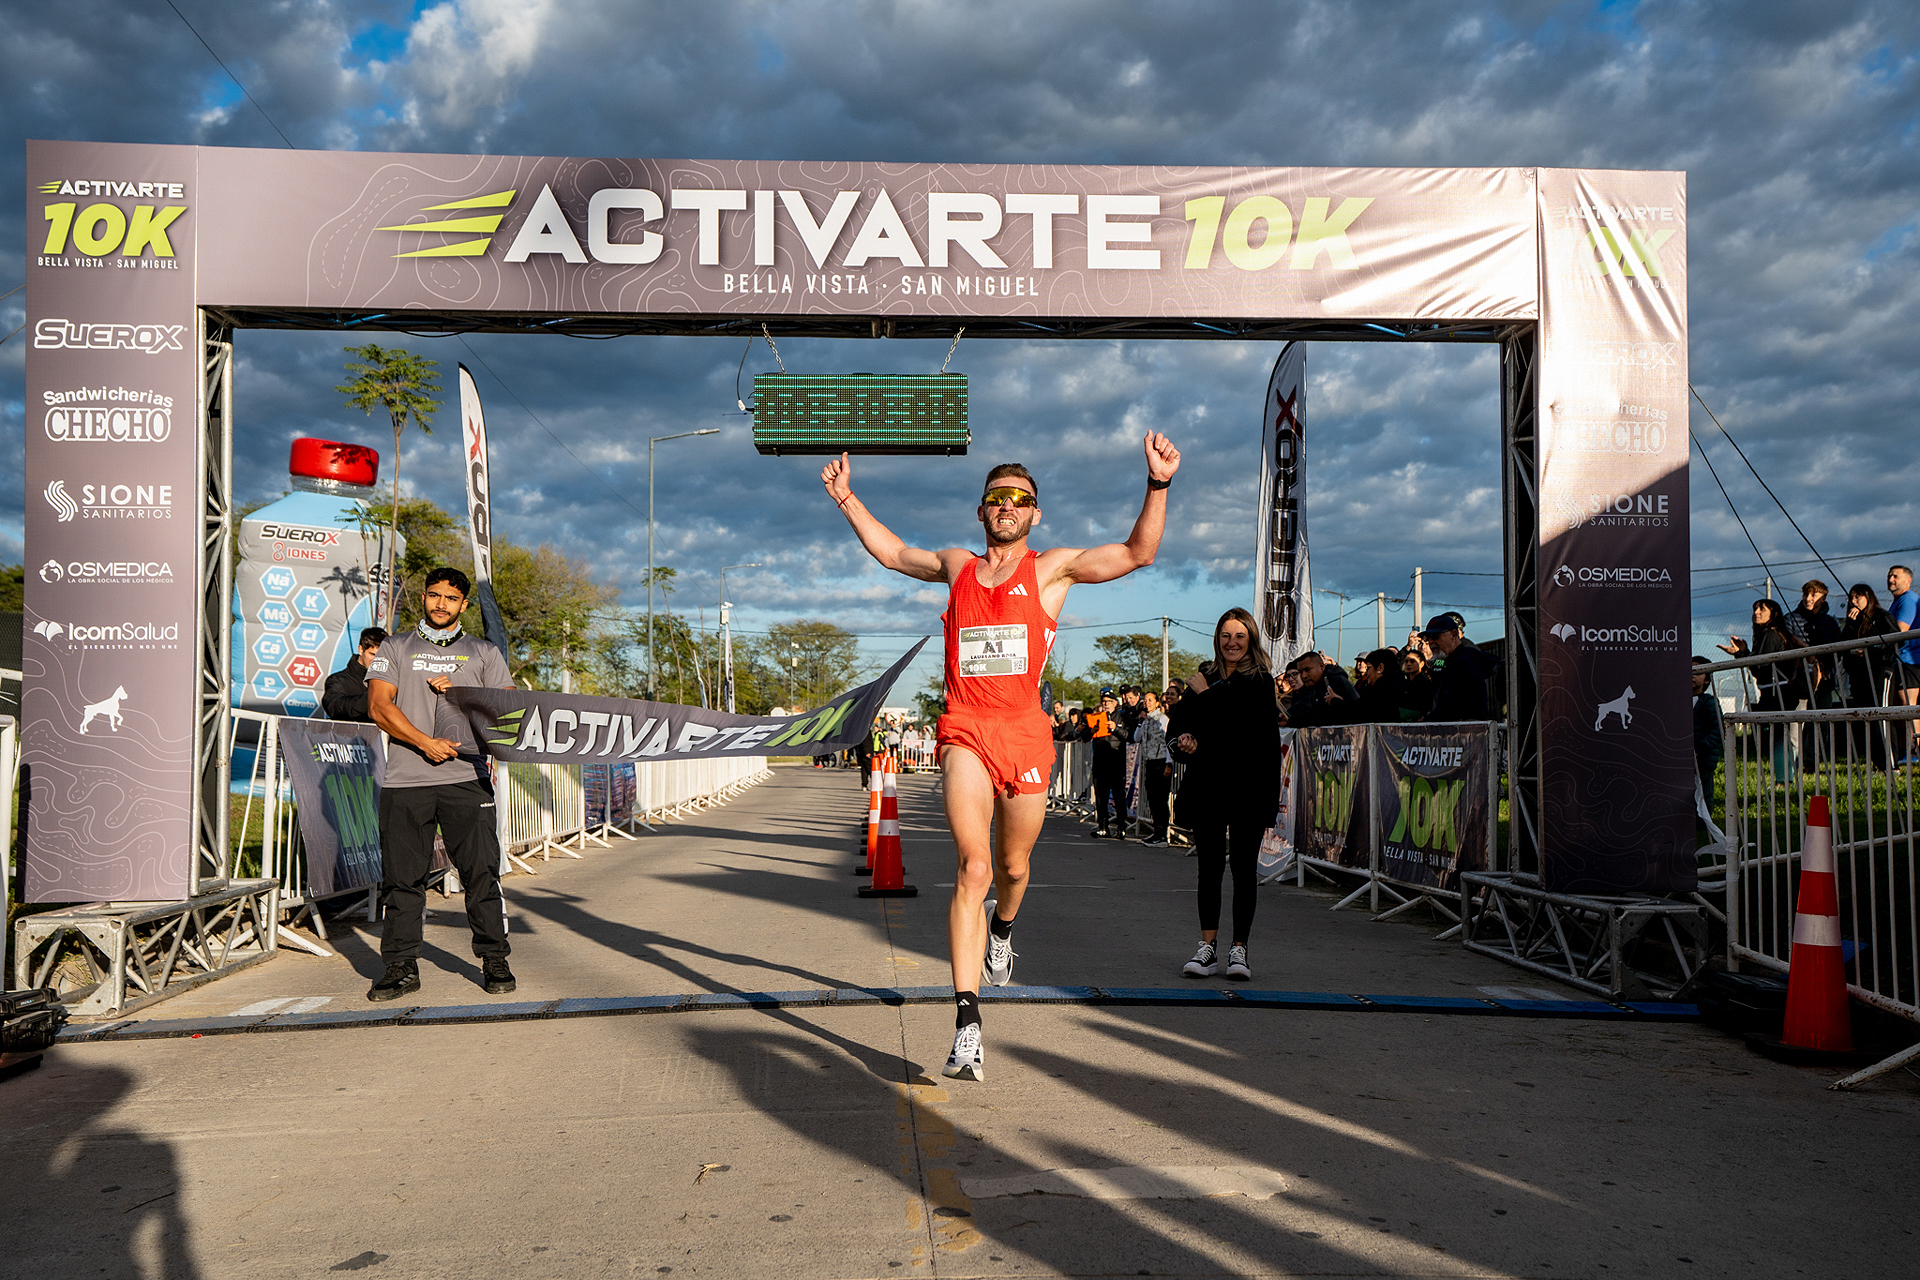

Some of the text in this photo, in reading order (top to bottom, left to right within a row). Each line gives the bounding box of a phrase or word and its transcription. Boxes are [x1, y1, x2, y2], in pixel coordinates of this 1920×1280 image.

[59, 179, 184, 198] ACTIVARTE
[1566, 205, 1674, 221] ACTVARTE
[43, 202, 187, 257] 10K
[503, 182, 1376, 271] ACTIVARTE 10K
[37, 256, 70, 267] BELLA
[74, 257, 104, 268] VISTA
[117, 258, 137, 269] SAN
[141, 259, 179, 270] MIGUEL
[723, 273, 793, 295] BELLA
[806, 273, 870, 296] VISTA
[901, 275, 943, 296] SAN
[956, 275, 1039, 297] MIGUEL
[43, 386, 173, 408] Sandwicherias
[44, 406, 172, 442] CHECHO
[82, 484, 172, 506] SIONE
[1589, 494, 1668, 514] SIONE
[82, 508, 172, 519] SANITARIOS
[1590, 517, 1669, 527] SANITARIOS
[272, 541, 326, 561] 8 IONES
[67, 561, 174, 577] OSMEDICA
[1578, 567, 1672, 582] OSMEDICA
[267, 572, 290, 587] Na
[305, 594, 318, 608] K
[264, 607, 289, 624] Mg
[68, 621, 178, 642] IcomSalud
[1581, 625, 1678, 643] IcomSalud
[260, 640, 281, 655] Ca
[982, 640, 1003, 654] A1
[417, 653, 456, 661] ACTIVARTE
[293, 662, 315, 677] Zn
[969, 663, 987, 672] 10K
[264, 677, 276, 688] P
[516, 697, 862, 759] ACTIVARTE 10K
[317, 742, 369, 764] ACTIVARTE
[1317, 744, 1355, 762] ACTIVARTE
[1402, 746, 1463, 767] ACTIVARTE
[1388, 776, 1465, 853] 10K
[1406, 849, 1424, 864] VISTA
